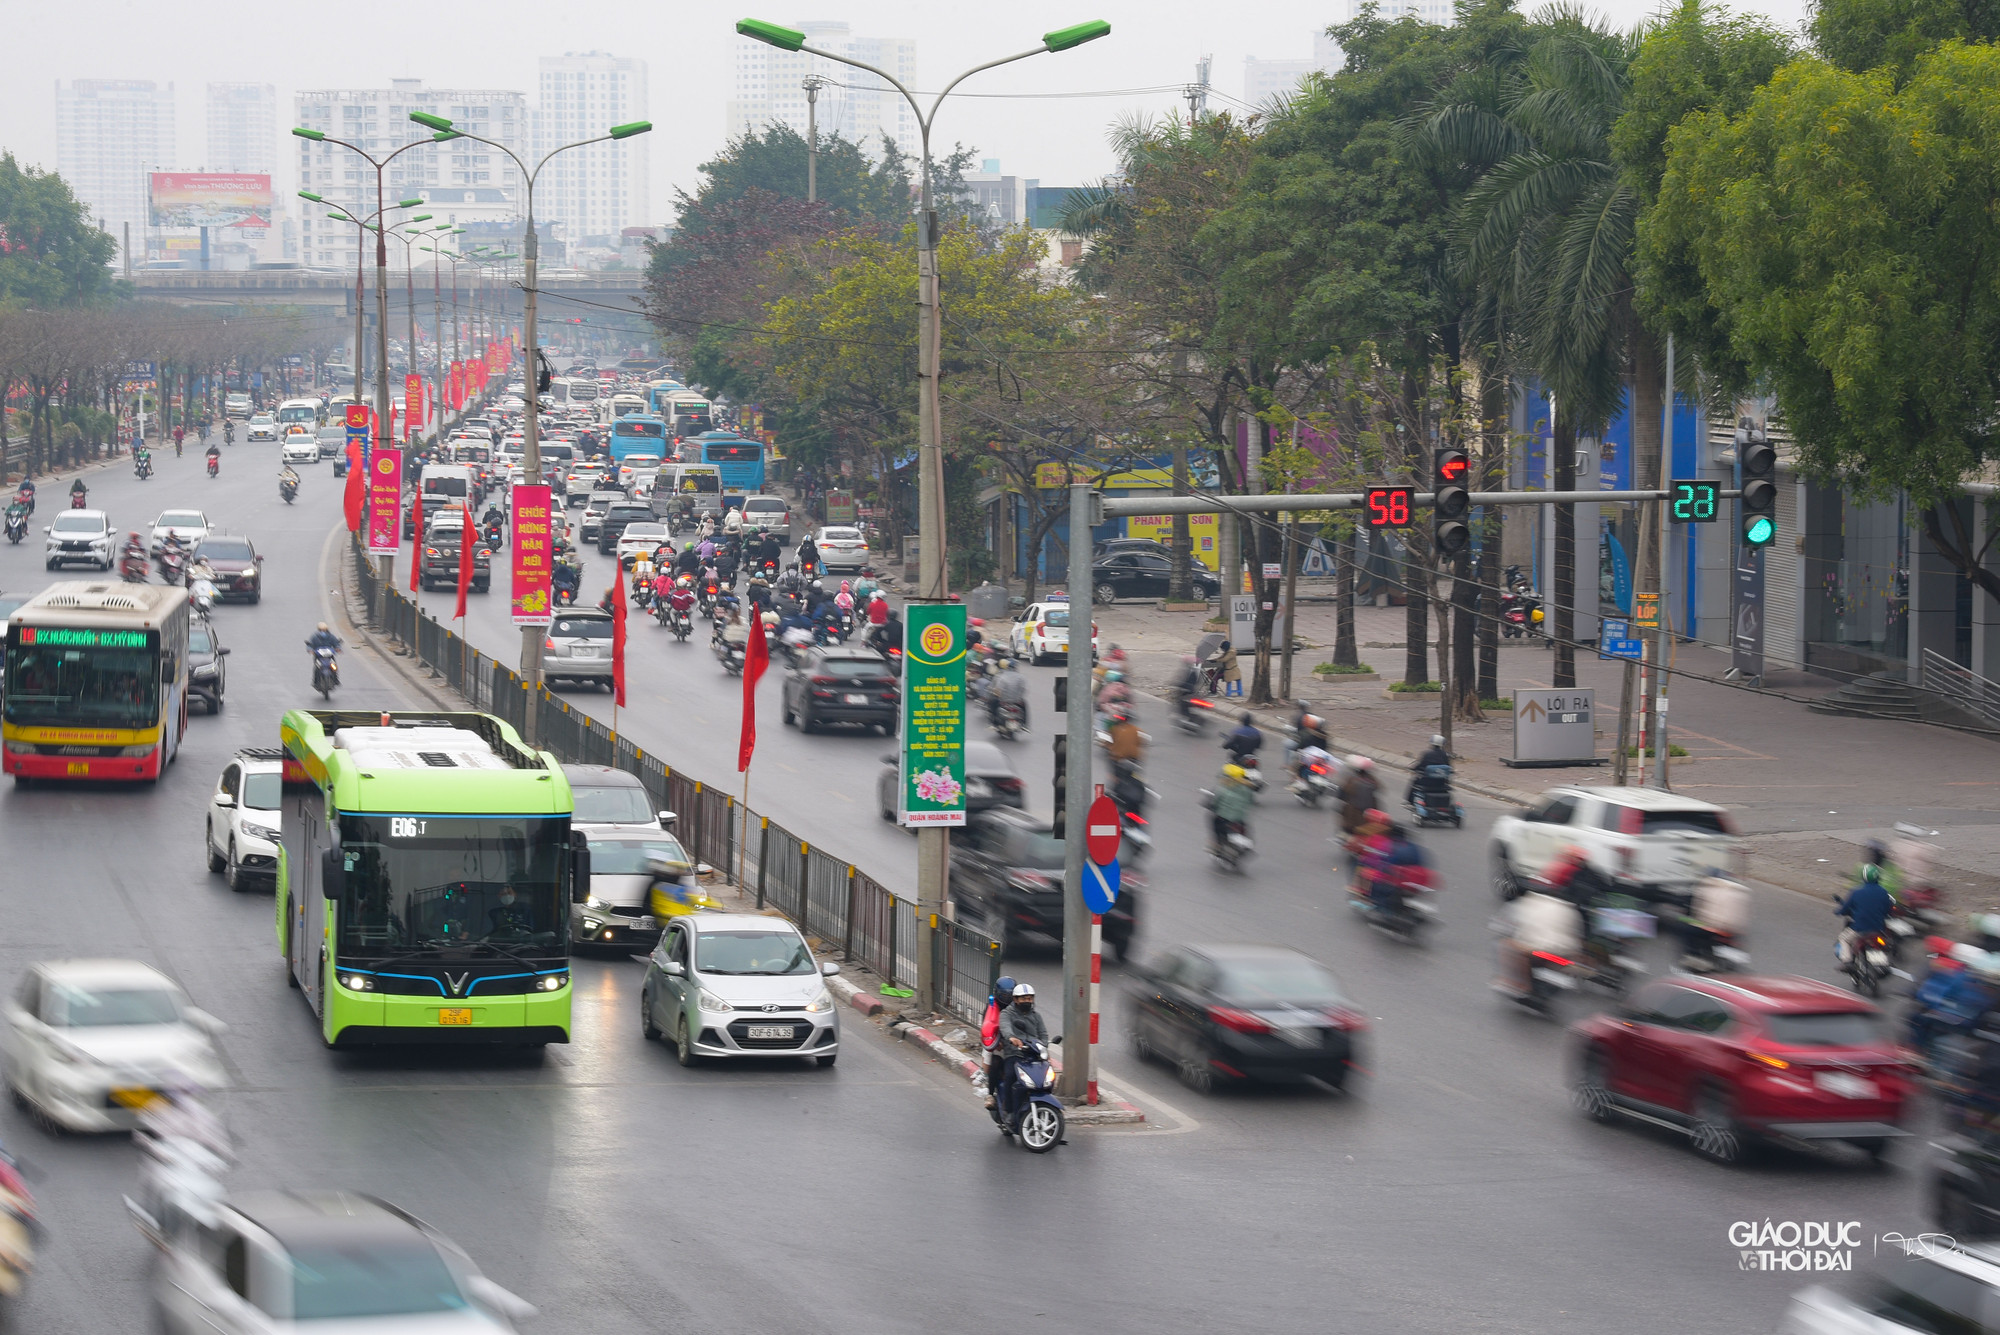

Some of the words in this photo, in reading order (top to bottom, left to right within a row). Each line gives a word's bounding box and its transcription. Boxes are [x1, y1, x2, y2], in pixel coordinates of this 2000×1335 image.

[518, 506, 546, 518] CHÚC
[1369, 490, 1409, 525] 58
[518, 522, 547, 534] MỪNG
[521, 538, 544, 550] NĂM
[523, 554, 542, 566] MỚI
[1637, 601, 1657, 619] LỐP
[1547, 696, 1565, 710] LỐI
[1573, 697, 1589, 710] RA
[1562, 713, 1578, 723] OUT
[909, 813, 926, 822] QUẬN
[928, 813, 948, 821] HOÀNG
[950, 813, 963, 821] MAI
[391, 817, 417, 837] E06
[748, 1028, 793, 1038] 30F-614.39
